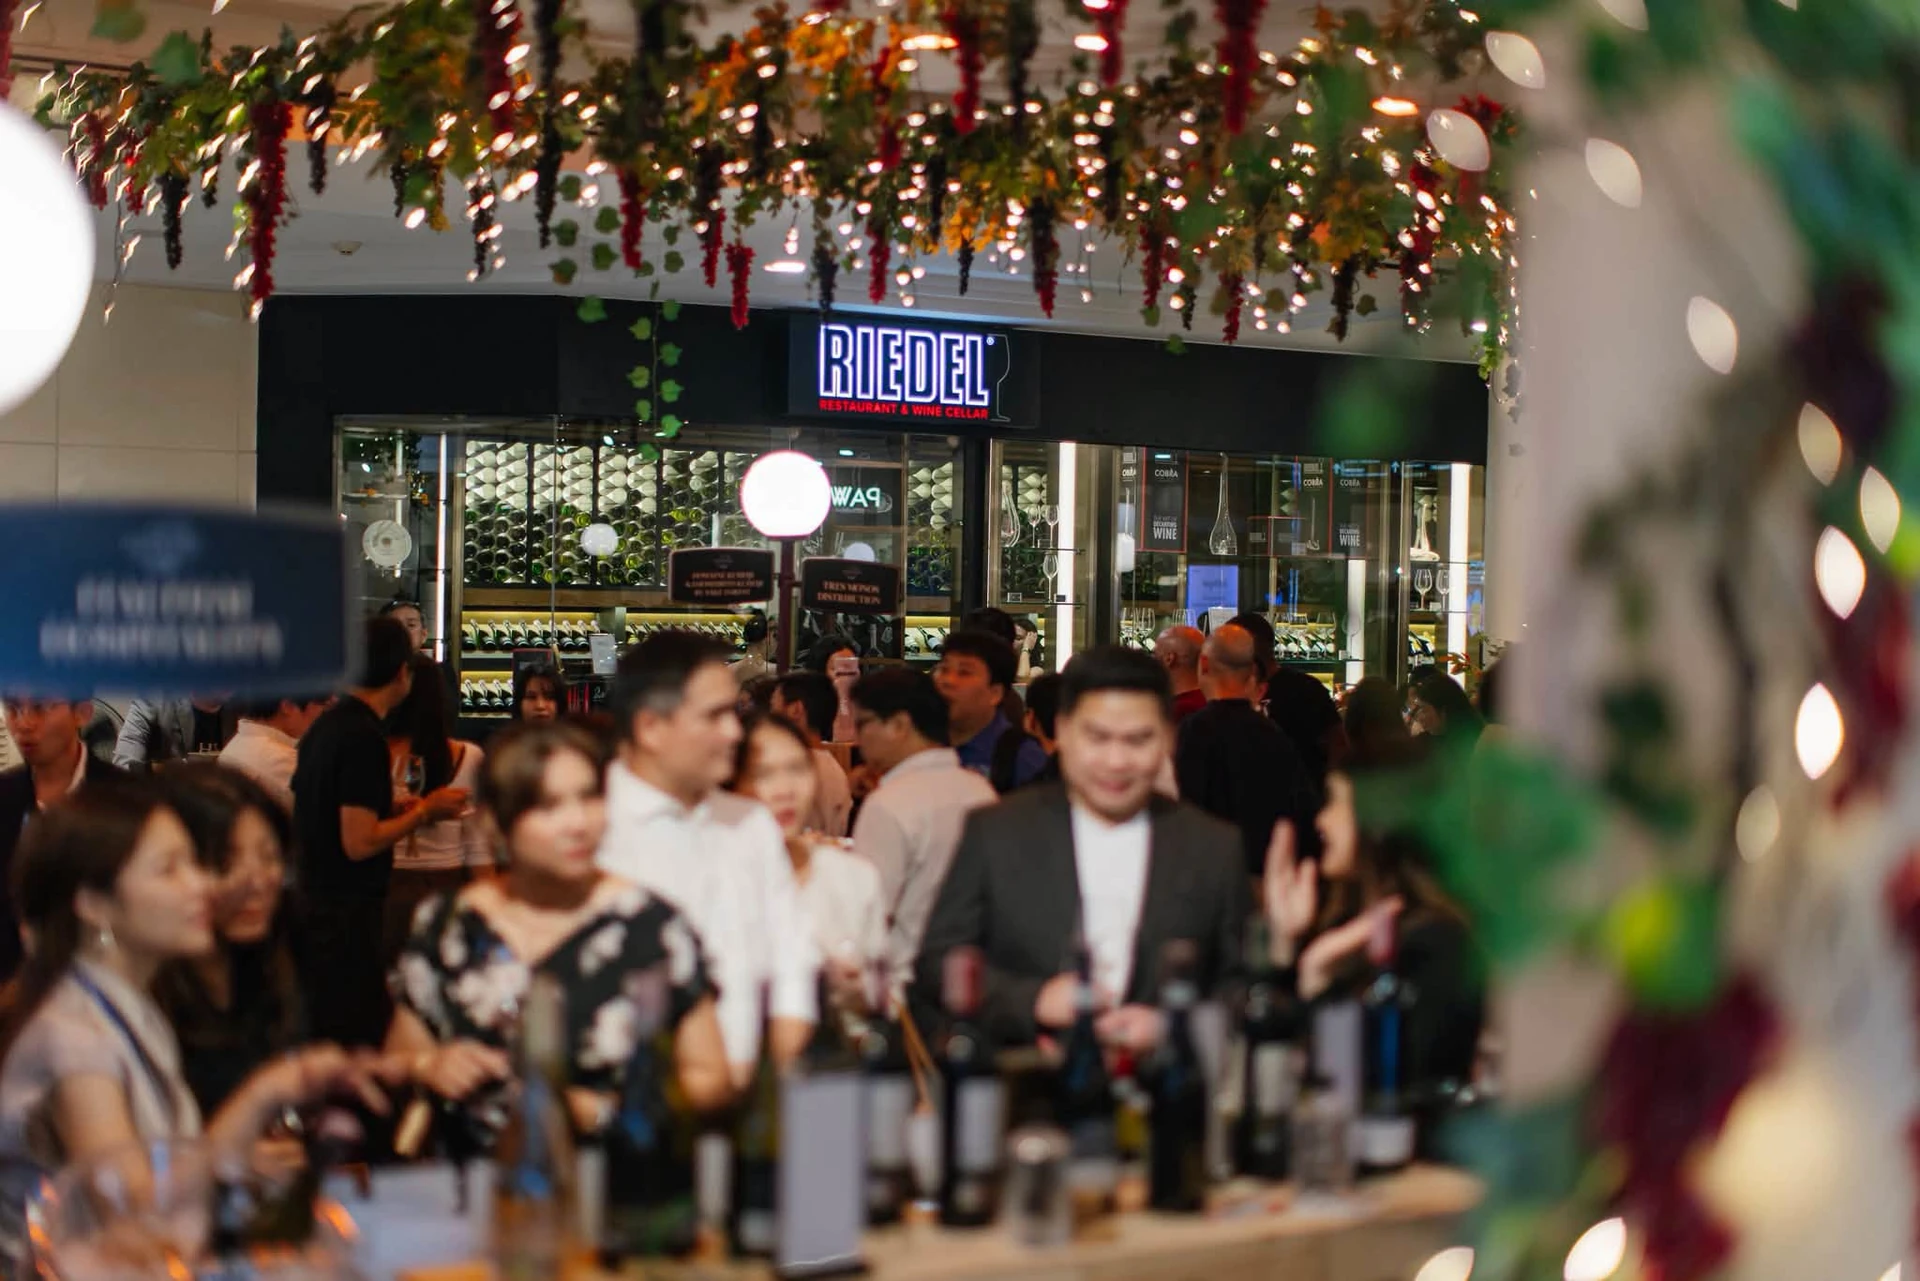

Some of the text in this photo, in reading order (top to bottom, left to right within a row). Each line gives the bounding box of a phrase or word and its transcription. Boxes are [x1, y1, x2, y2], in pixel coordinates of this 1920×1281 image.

[819, 398, 988, 419] RESTAURANT & WINE CELLAR
[1154, 468, 1179, 478] COBRA
[1153, 527, 1177, 540] WINE
[1339, 534, 1361, 547] WINE
